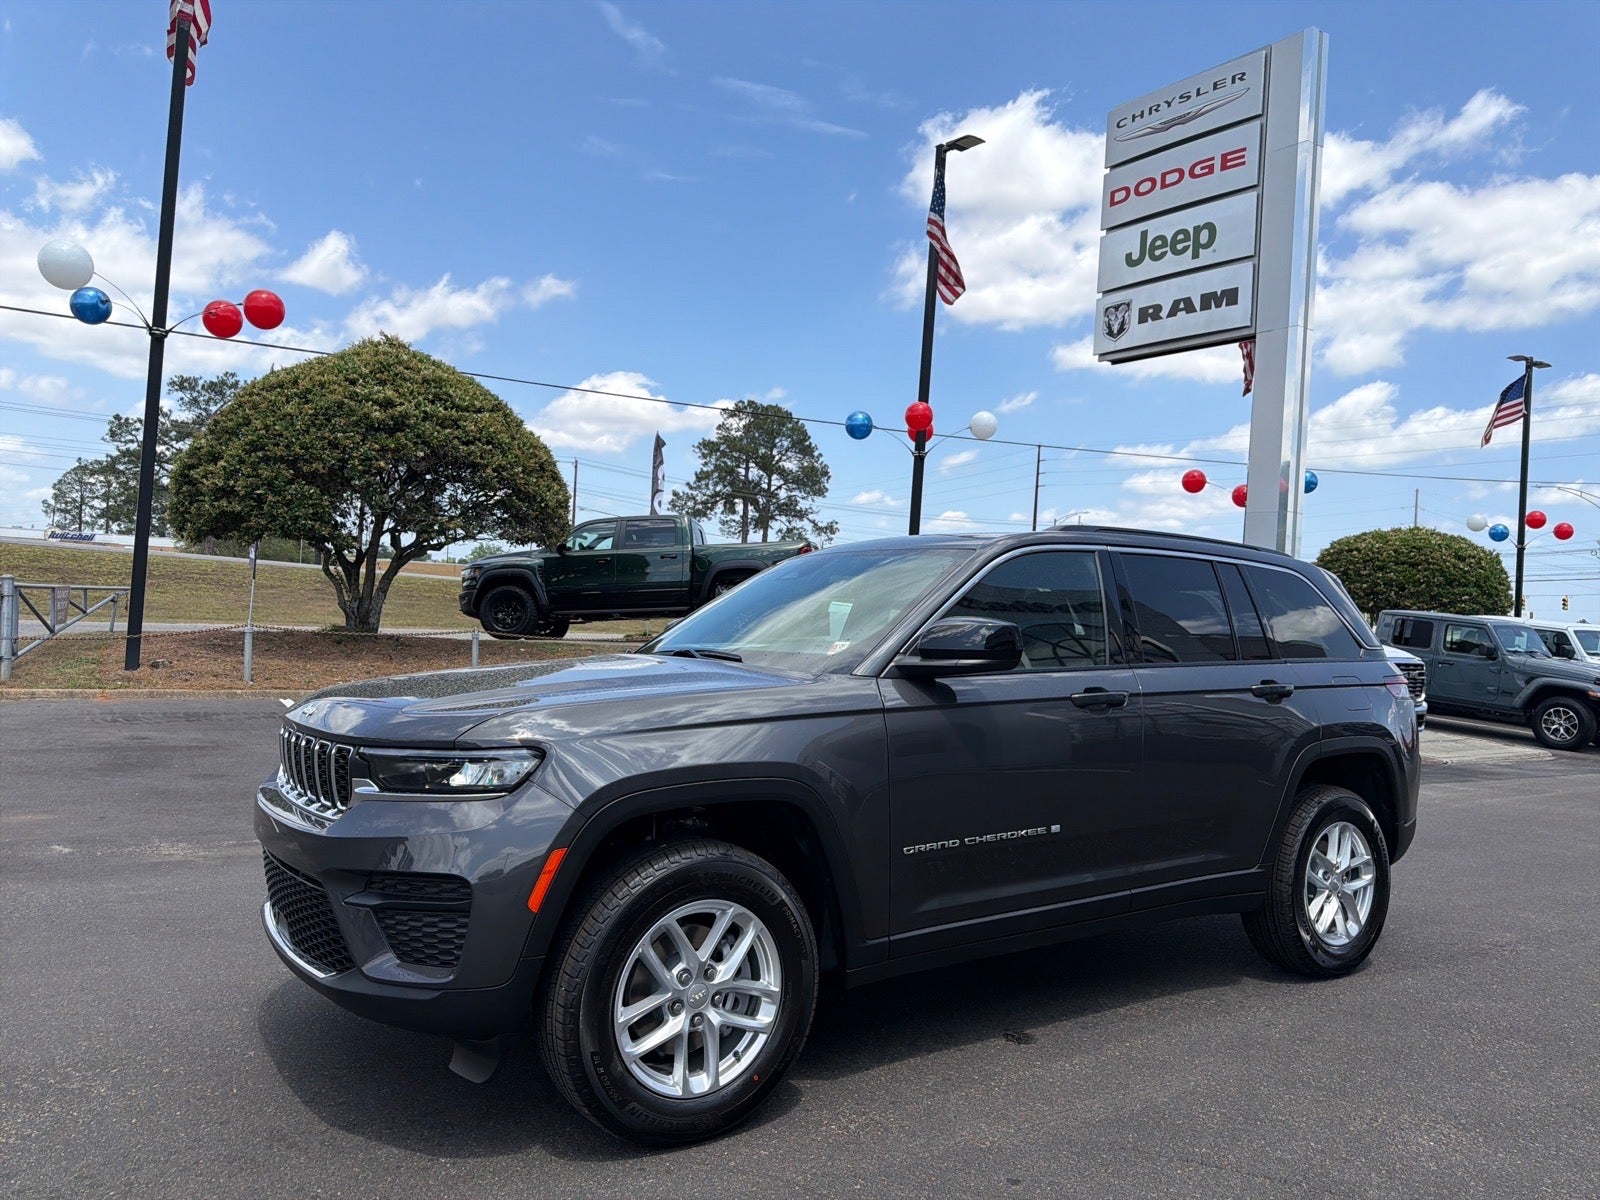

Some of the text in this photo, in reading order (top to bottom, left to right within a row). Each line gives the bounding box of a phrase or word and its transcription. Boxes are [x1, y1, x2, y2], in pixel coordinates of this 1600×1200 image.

[1116, 71, 1247, 129] CHRYSLER
[1109, 147, 1247, 208] DODGE
[1125, 221, 1217, 268] Jeep
[1138, 287, 1239, 324] RAM
[48, 530, 96, 541] Twitchell
[903, 827, 1047, 855] GRAND CHEROKEE
